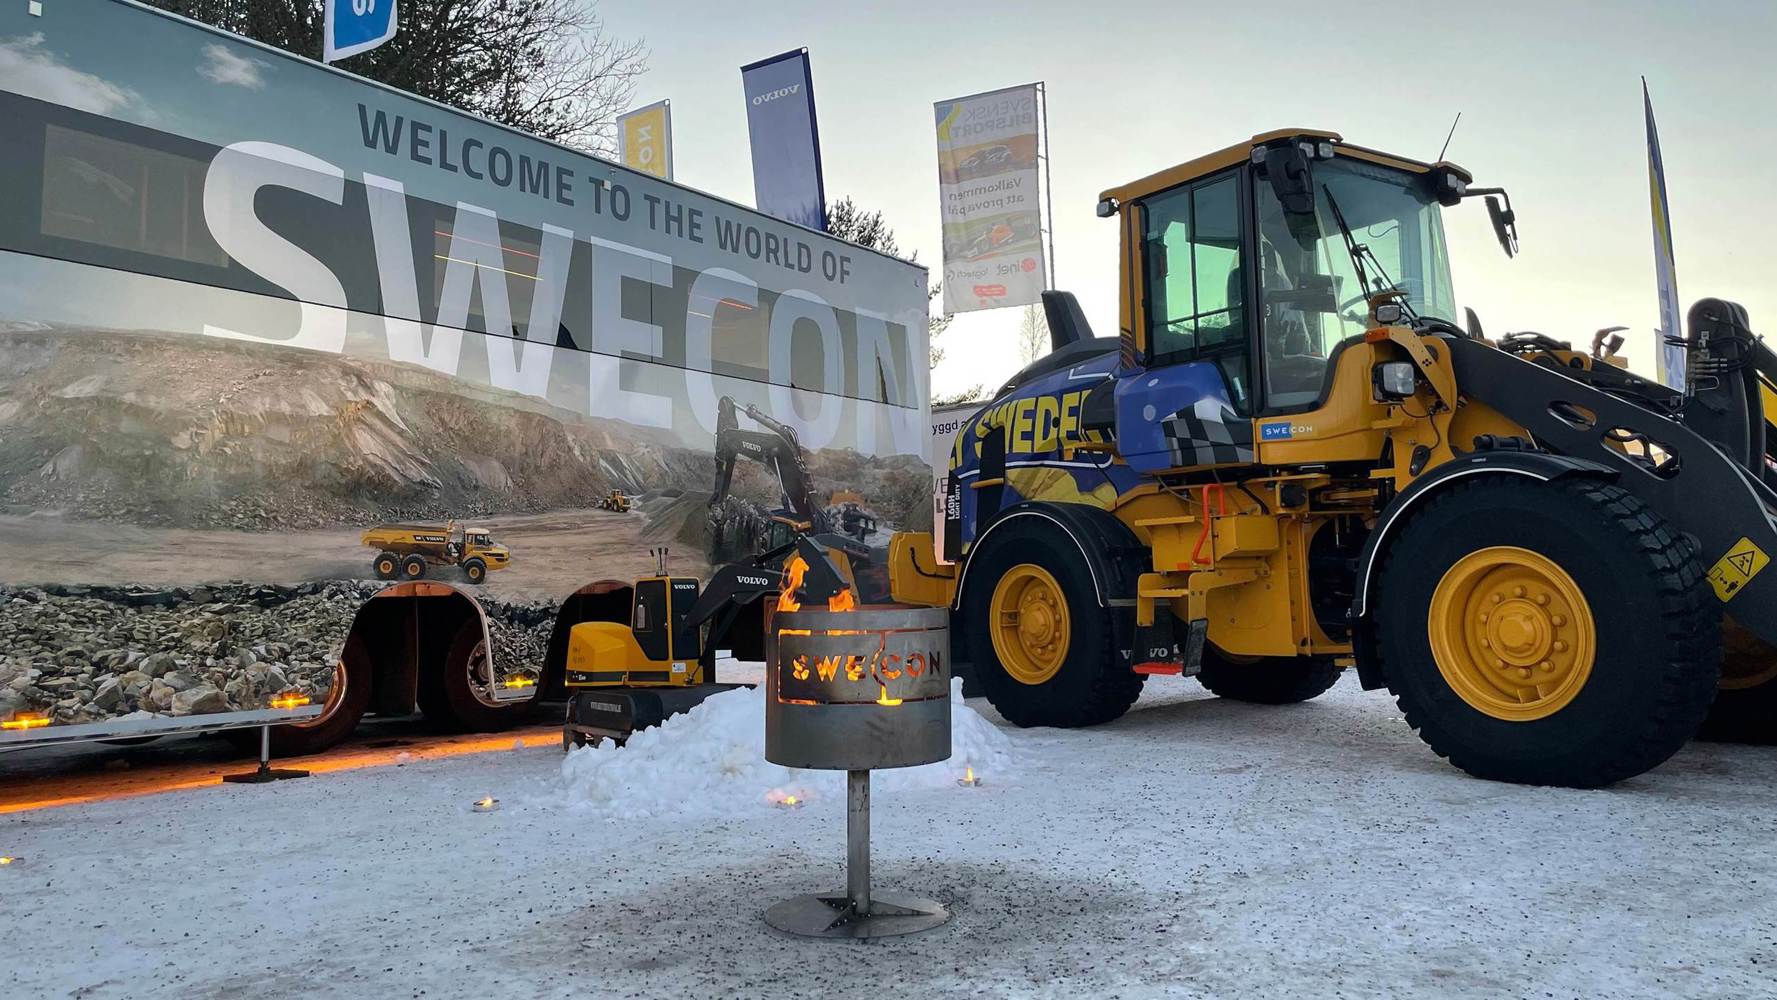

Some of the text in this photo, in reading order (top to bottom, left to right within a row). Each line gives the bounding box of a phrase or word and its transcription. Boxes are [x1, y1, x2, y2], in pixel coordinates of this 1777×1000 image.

[357, 103, 852, 284] WELCOME TO THE WORLD OF
[203, 141, 928, 460] SWECON
[932, 420, 958, 435] yggd
[974, 390, 1103, 455] SWEDE
[1266, 426, 1313, 436] SWECON
[742, 441, 762, 452] VOLVO
[736, 575, 768, 586] VOLVO
[792, 651, 941, 683] SWECON
